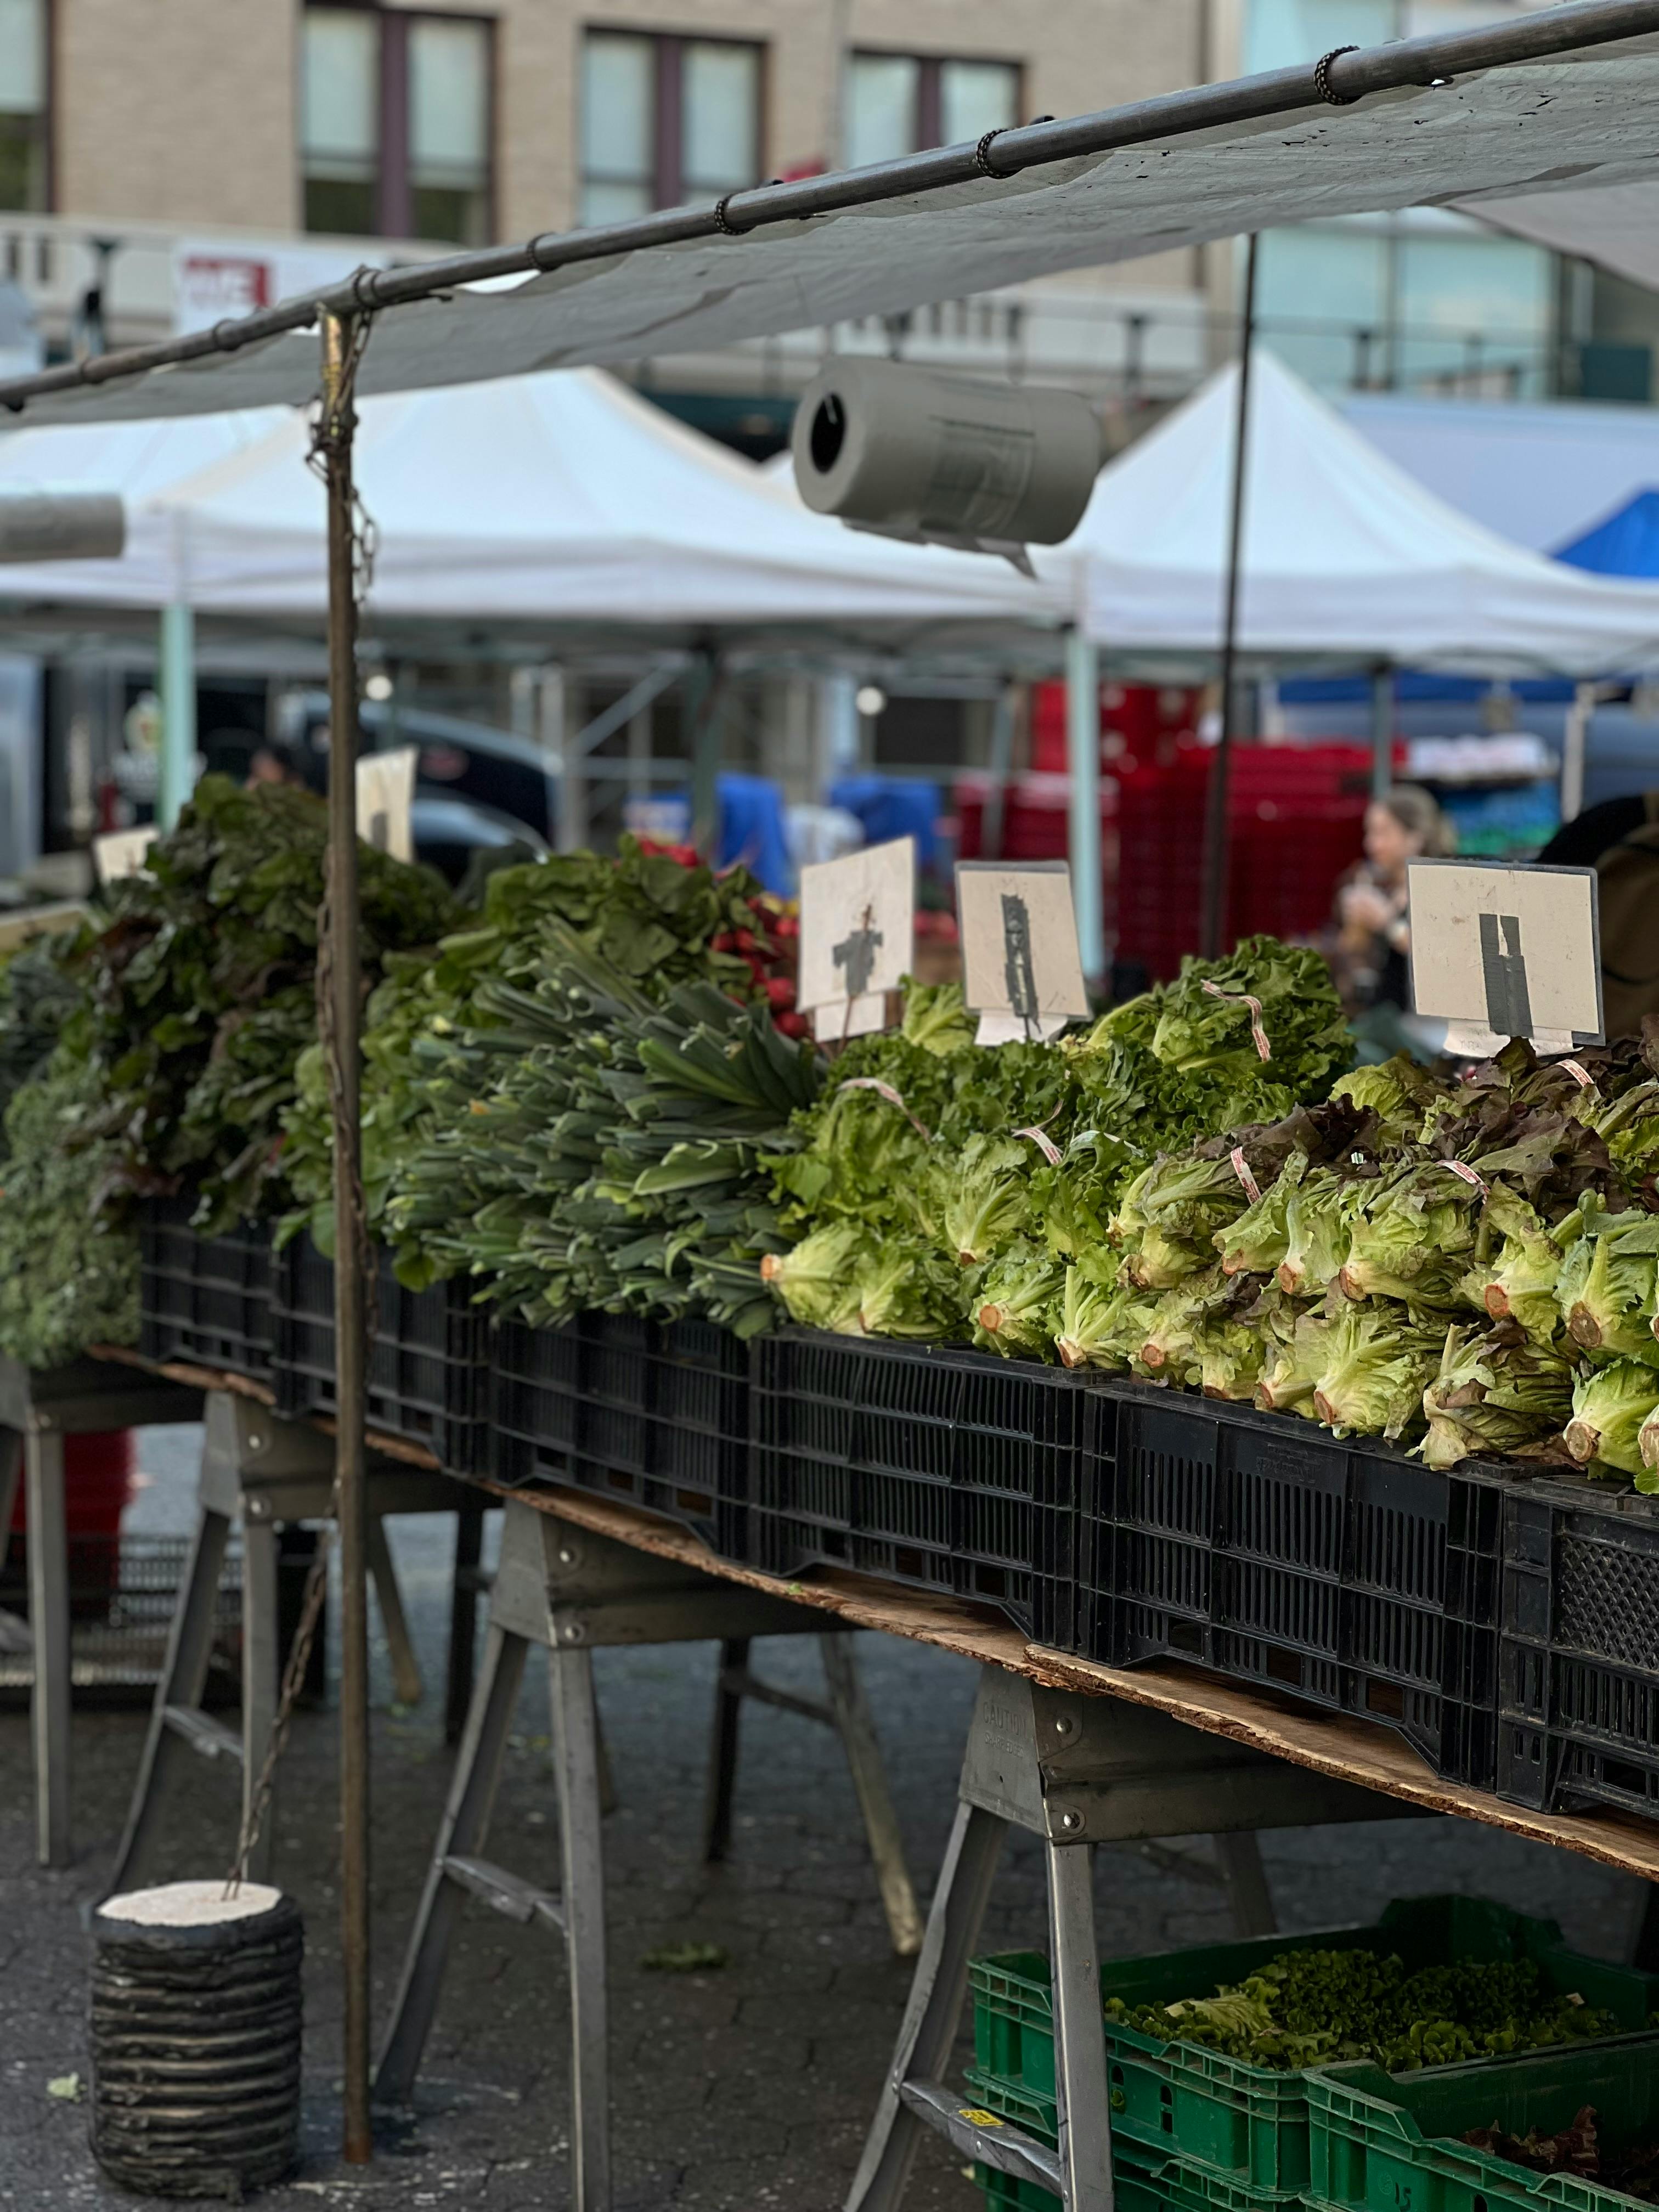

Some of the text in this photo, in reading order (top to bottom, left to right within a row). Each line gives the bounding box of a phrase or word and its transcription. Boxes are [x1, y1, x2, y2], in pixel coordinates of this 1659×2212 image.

[983, 1701, 1026, 1738] CAUTION
[984, 1731, 1005, 1748] SHARP
[1395, 2182, 1412, 2211] 15
